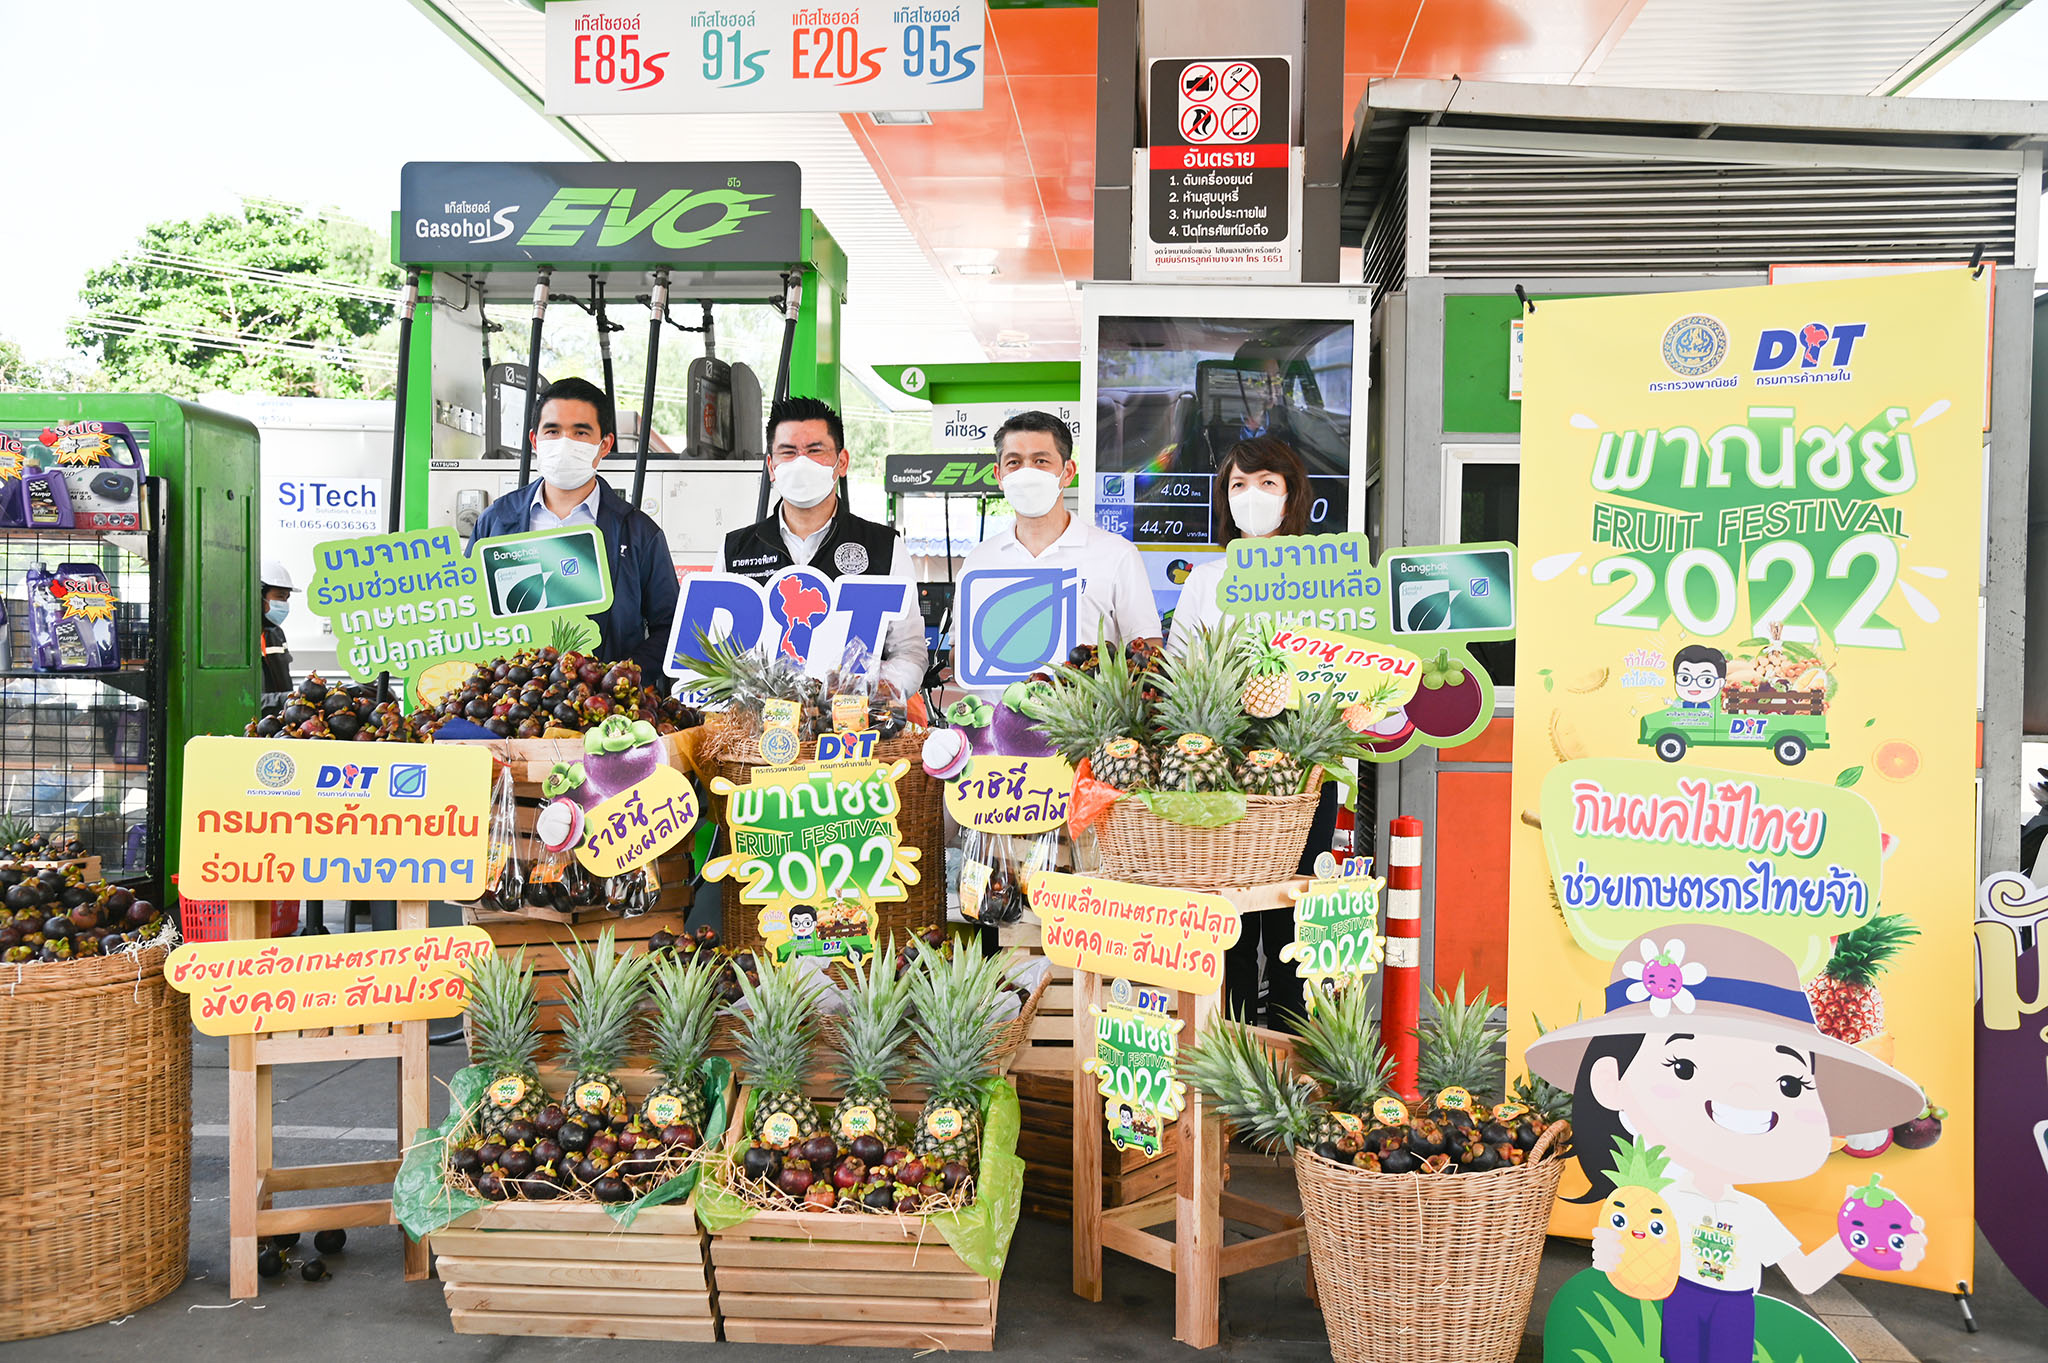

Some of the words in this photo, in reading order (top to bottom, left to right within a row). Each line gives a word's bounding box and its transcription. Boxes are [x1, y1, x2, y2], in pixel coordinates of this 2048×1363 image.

[574, 13, 641, 32] แก๊สโซฮอล์
[690, 10, 756, 28] แก๊สโซฮอล์
[791, 8, 859, 26] แก๊สโซฮอล์
[894, 6, 960, 24] แก๊สโซฮอล์
[1183, 148, 1255, 168] อันตราย
[1183, 170, 1253, 186] ดับเครื่องยนต์
[444, 200, 491, 215] แก๊สโซฮอล์
[1183, 187, 1239, 206] ห้ามสูบบุหรี่
[517, 187, 776, 249] EVO
[1183, 206, 1267, 220] ห้ามก่อประกายไฟ
[1182, 224, 1269, 237] ปิดโทรศัพท์มือถือ
[1262, 255, 1283, 263] 1651
[906, 371, 918, 388] 4
[1649, 375, 1738, 392] กระทรวงพาณิชย์
[1756, 367, 1852, 386] กรมการค้าภายใน
[55, 420, 103, 437] sale
[1591, 405, 1918, 495] พาณิชย์
[1160, 484, 1191, 497] 4.03
[1139, 520, 1183, 535] 44.70
[1592, 502, 1702, 553] FRUIT
[1717, 498, 1910, 548] FESTIVAL
[324, 535, 451, 571] บางจากฯ
[1236, 541, 1359, 570] บางจากฯ
[1400, 561, 1449, 574] Bangchak
[65, 576, 111, 594] sale
[317, 561, 477, 605] ร่วมช่วยเหลือ
[1225, 570, 1382, 603] ร่วมช่วยเหลือ
[1591, 533, 1906, 650] 2022
[340, 595, 477, 635] เกษตรกร
[349, 621, 533, 675] ผู้ปลูกสับปะรด
[247, 788, 301, 797] กระทรวงพาณิชย์
[317, 790, 371, 798] กรมการค้าภายใน
[958, 762, 1026, 801] ราชินี
[731, 769, 896, 824] พาณิชย์
[197, 804, 479, 838] กรมการค้าภายใน
[588, 790, 648, 858] ราชินี
[1572, 777, 1822, 853] กินผลไม้ไทย
[735, 830, 793, 858] FRUIT
[801, 818, 897, 850] FESTIVAL
[201, 853, 295, 884] ร่วมใจ
[302, 857, 474, 884] บางจากฯ
[739, 836, 903, 900] 2022
[1300, 884, 1376, 921] พาณิชย์
[1562, 861, 1868, 915] ช่วยเกษตรกรไทยจ้า
[1047, 917, 1102, 969] มังคุด
[1106, 941, 1128, 956] และ
[1133, 932, 1216, 978] สับปะรด
[1300, 926, 1328, 943] FRUIT
[1300, 928, 1377, 975] 2022
[203, 986, 296, 1032] มังคุด
[303, 993, 336, 1009] และ
[346, 976, 464, 1008] สับปะรด
[1097, 1014, 1175, 1057] พาณิชย์
[1097, 1044, 1124, 1065] FRUIT
[1099, 1065, 1175, 1117] 2022
[1692, 1246, 1735, 1270] 2022
